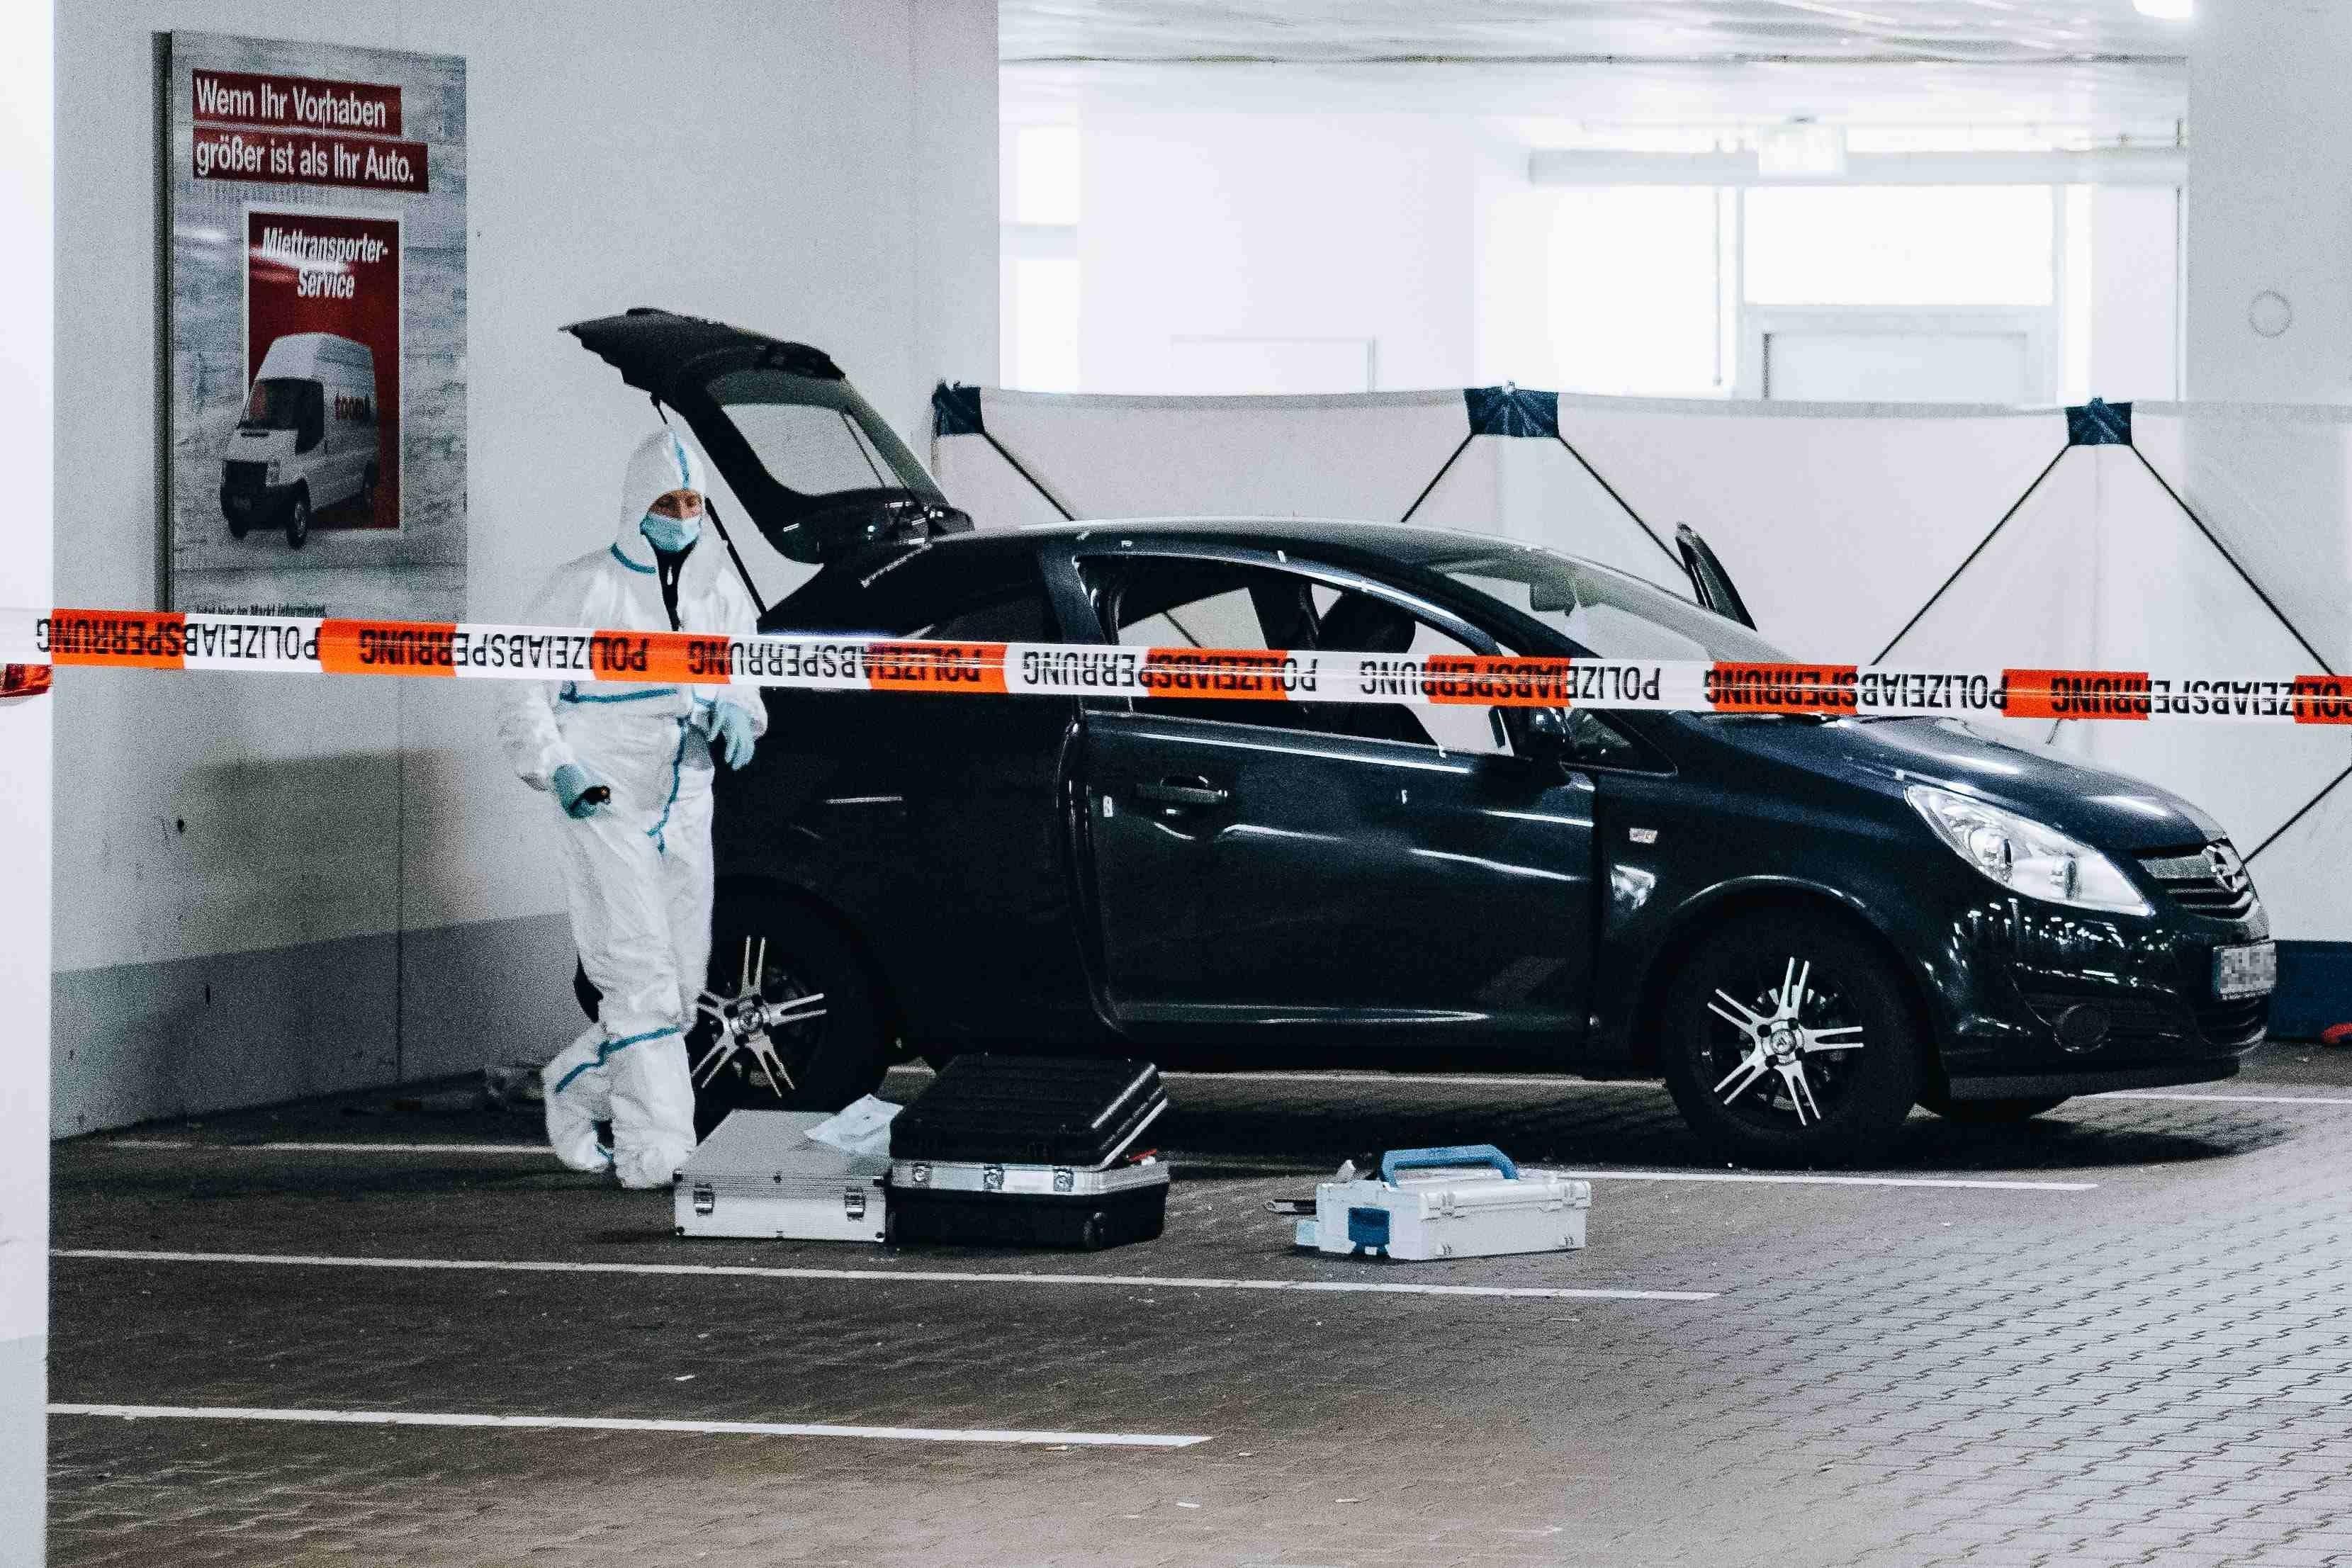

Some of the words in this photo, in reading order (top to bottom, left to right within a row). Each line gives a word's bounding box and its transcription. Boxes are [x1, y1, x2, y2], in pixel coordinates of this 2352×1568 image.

[196, 77, 254, 117] Wenn
[261, 82, 288, 119] Ihr
[293, 86, 386, 128] Vorhaben
[196, 135, 265, 176] größer
[270, 138, 295, 175] ist
[300, 142, 329, 177] als
[333, 142, 361, 180] Ihr
[364, 147, 415, 184] Auto.
[261, 226, 389, 264] Miettransporter-
[296, 267, 356, 300] Service
[35, 617, 322, 661] POLIZEIABSPERRUNG
[359, 628, 651, 672] POLIZEIABSPERRUNG
[686, 639, 981, 682] POLIZEIABSPERRUNG
[1021, 650, 1319, 693] POLIZEIABSPERRUNG
[1358, 659, 1662, 701] POLIZEIABSPERRUNG
[1703, 668, 2010, 711] POLIZEIABSPERRUNG
